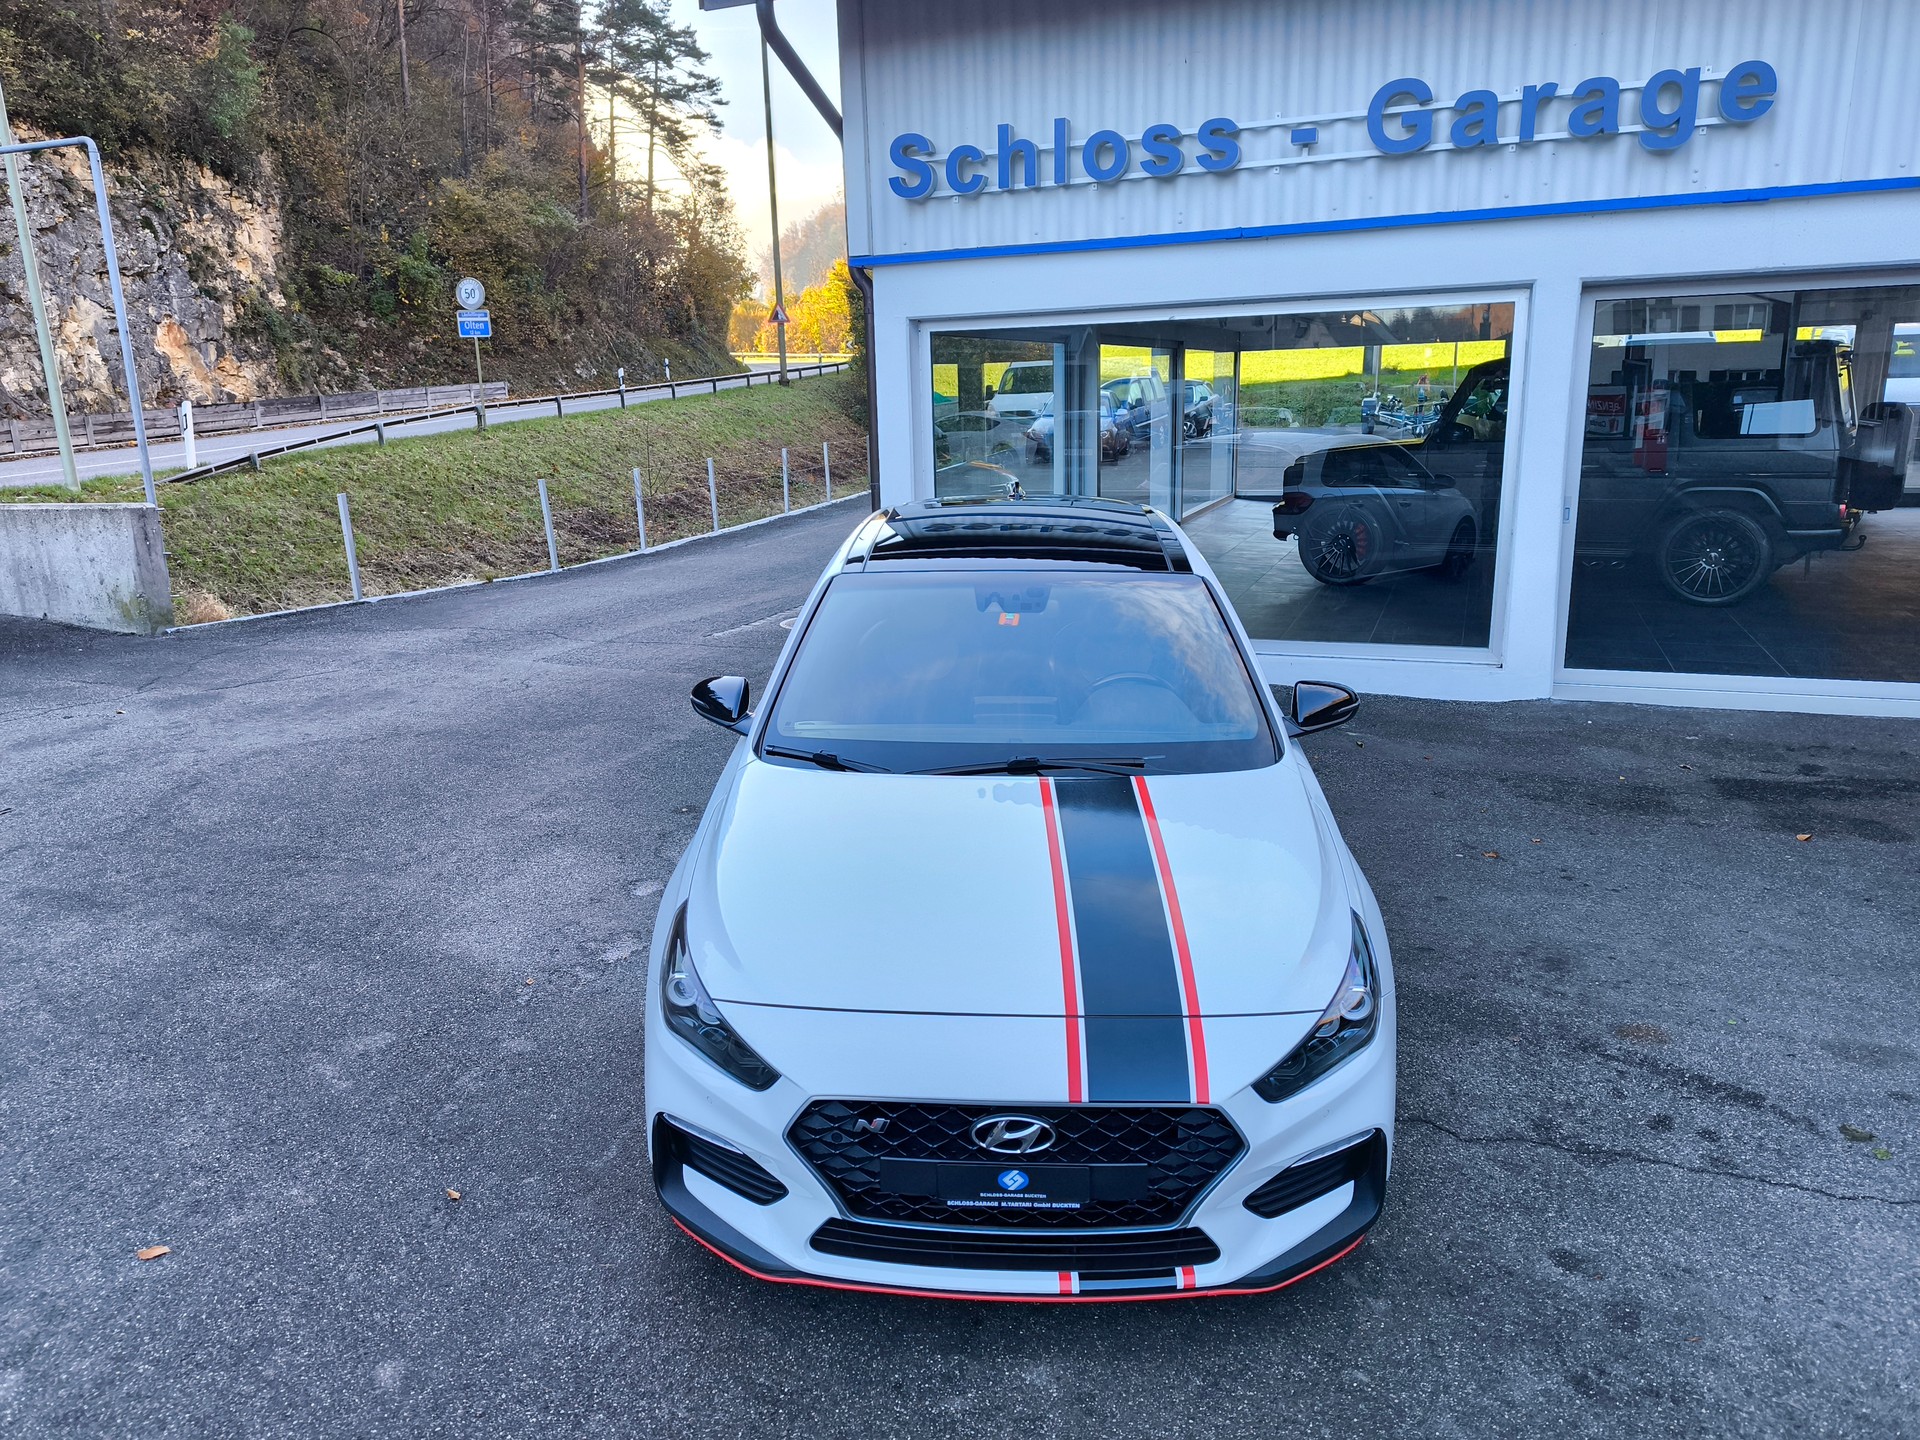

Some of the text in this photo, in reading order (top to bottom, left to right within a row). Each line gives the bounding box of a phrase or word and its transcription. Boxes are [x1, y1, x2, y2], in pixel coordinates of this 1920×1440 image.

[888, 116, 1241, 199] Schloss
[1366, 60, 1778, 154] Garage
[464, 288, 476, 300] 50
[464, 321, 485, 330] Olten
